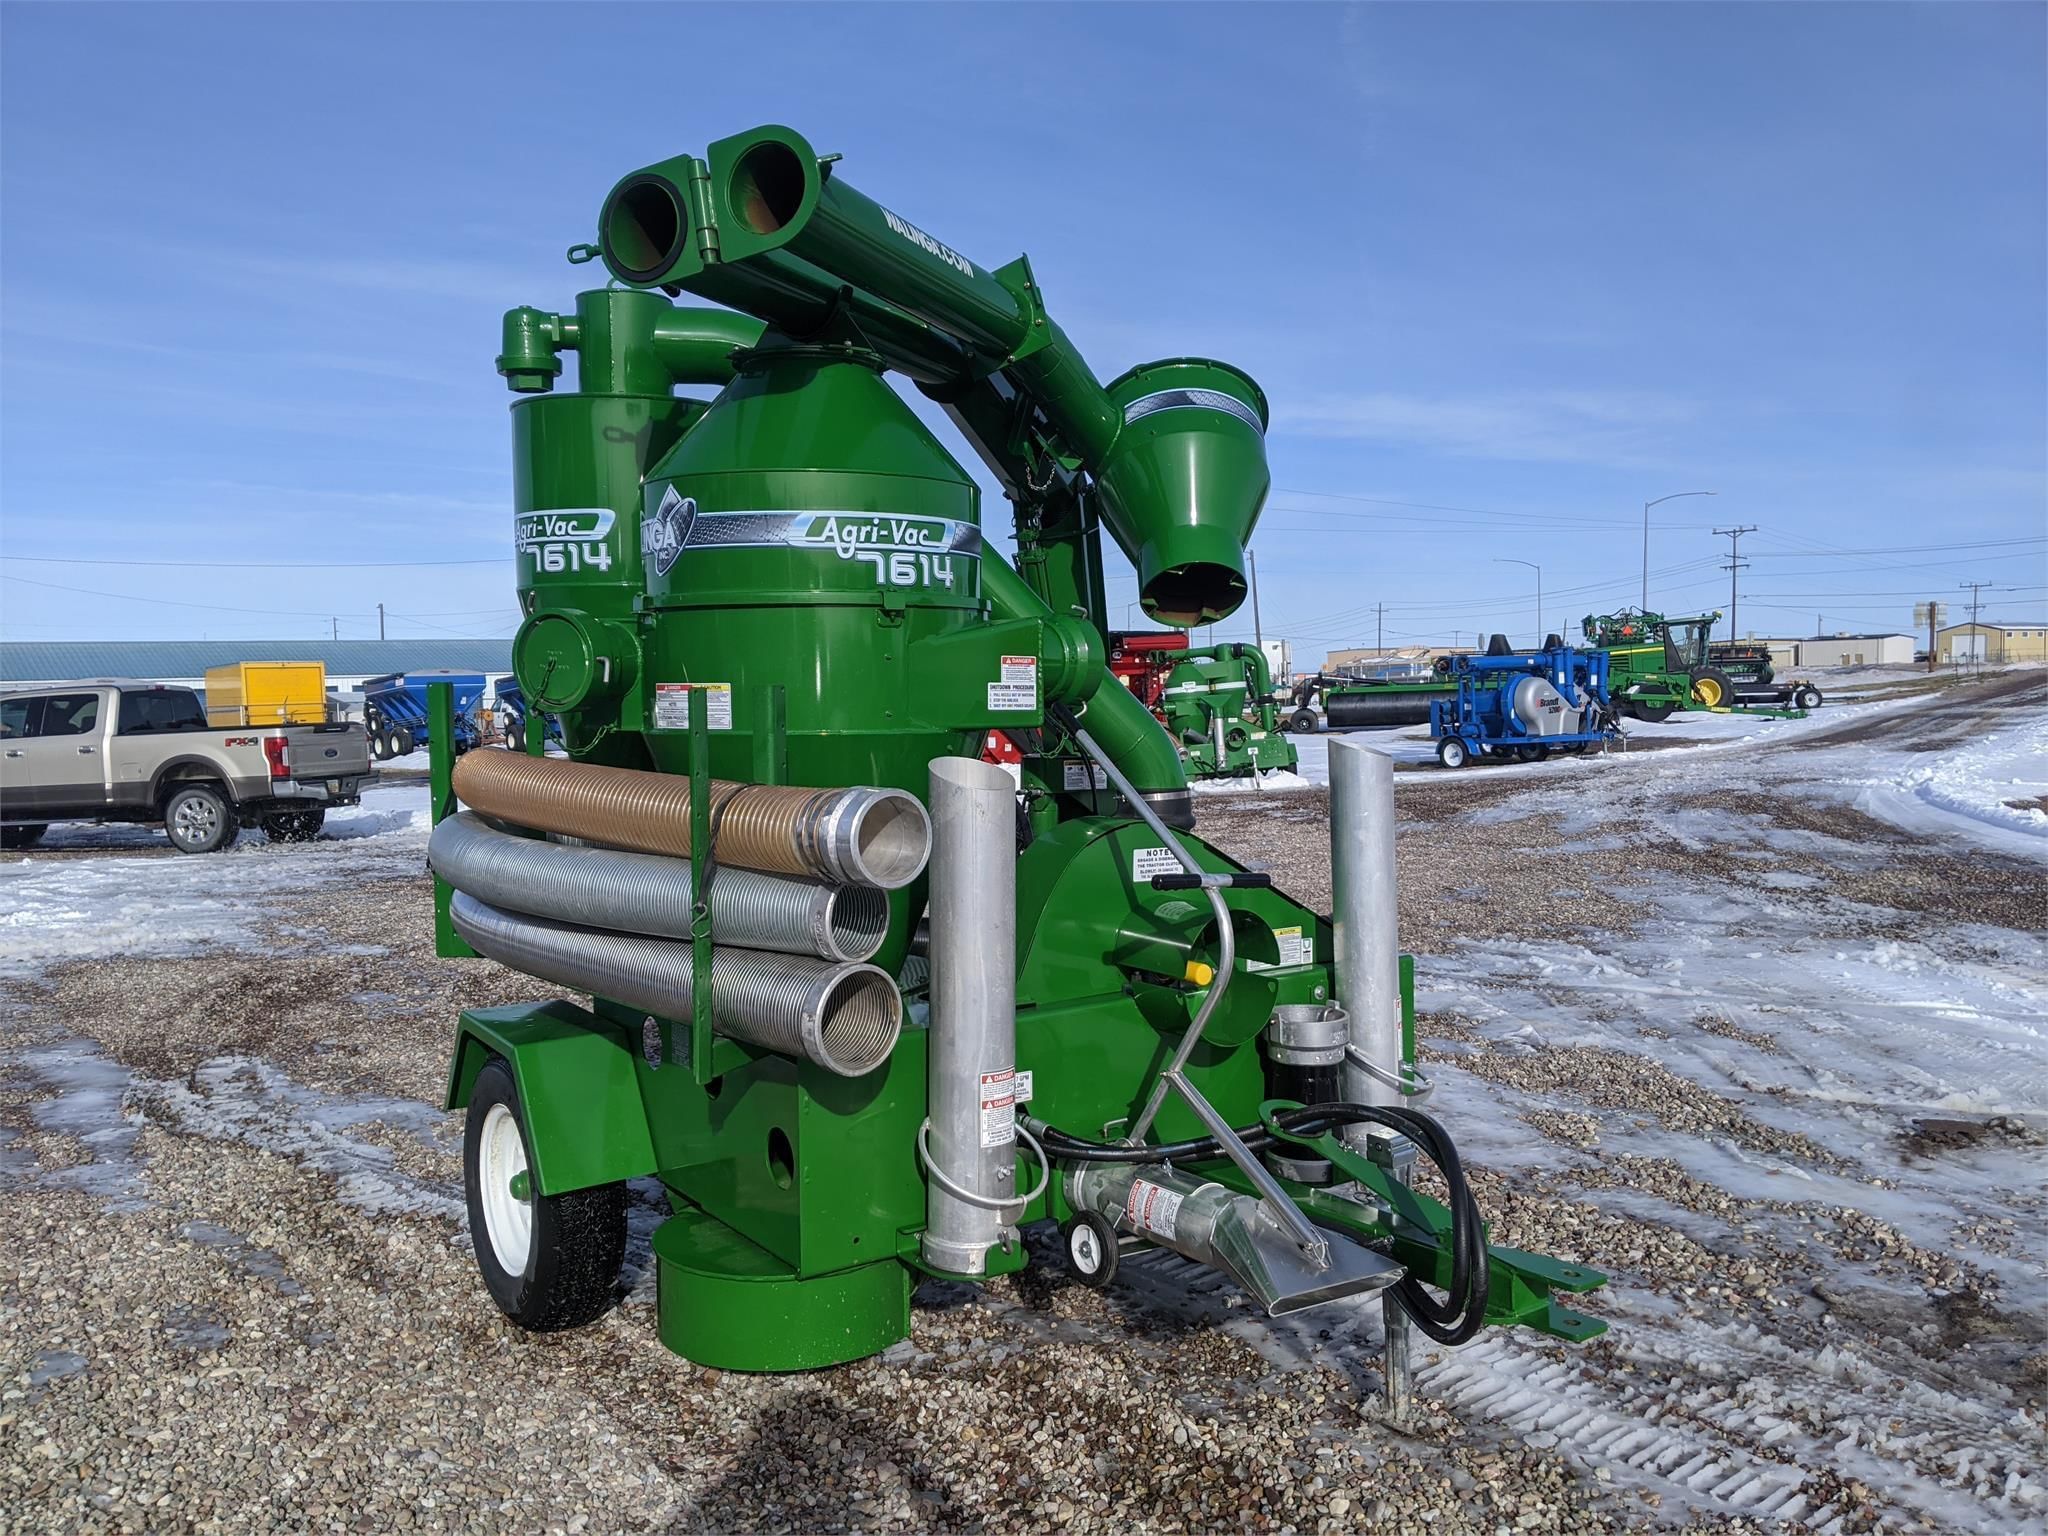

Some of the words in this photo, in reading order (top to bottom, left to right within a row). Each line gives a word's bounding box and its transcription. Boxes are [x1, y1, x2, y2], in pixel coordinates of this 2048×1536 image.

[879, 206, 974, 279] WALINGA.COM
[820, 517, 930, 559] Agri-Vac
[526, 543, 612, 573] 7614
[854, 551, 954, 588] 7614
[1146, 849, 1173, 857] NOTE
[994, 1071, 1014, 1082] DANGER
[994, 1096, 1014, 1107] DANGER
